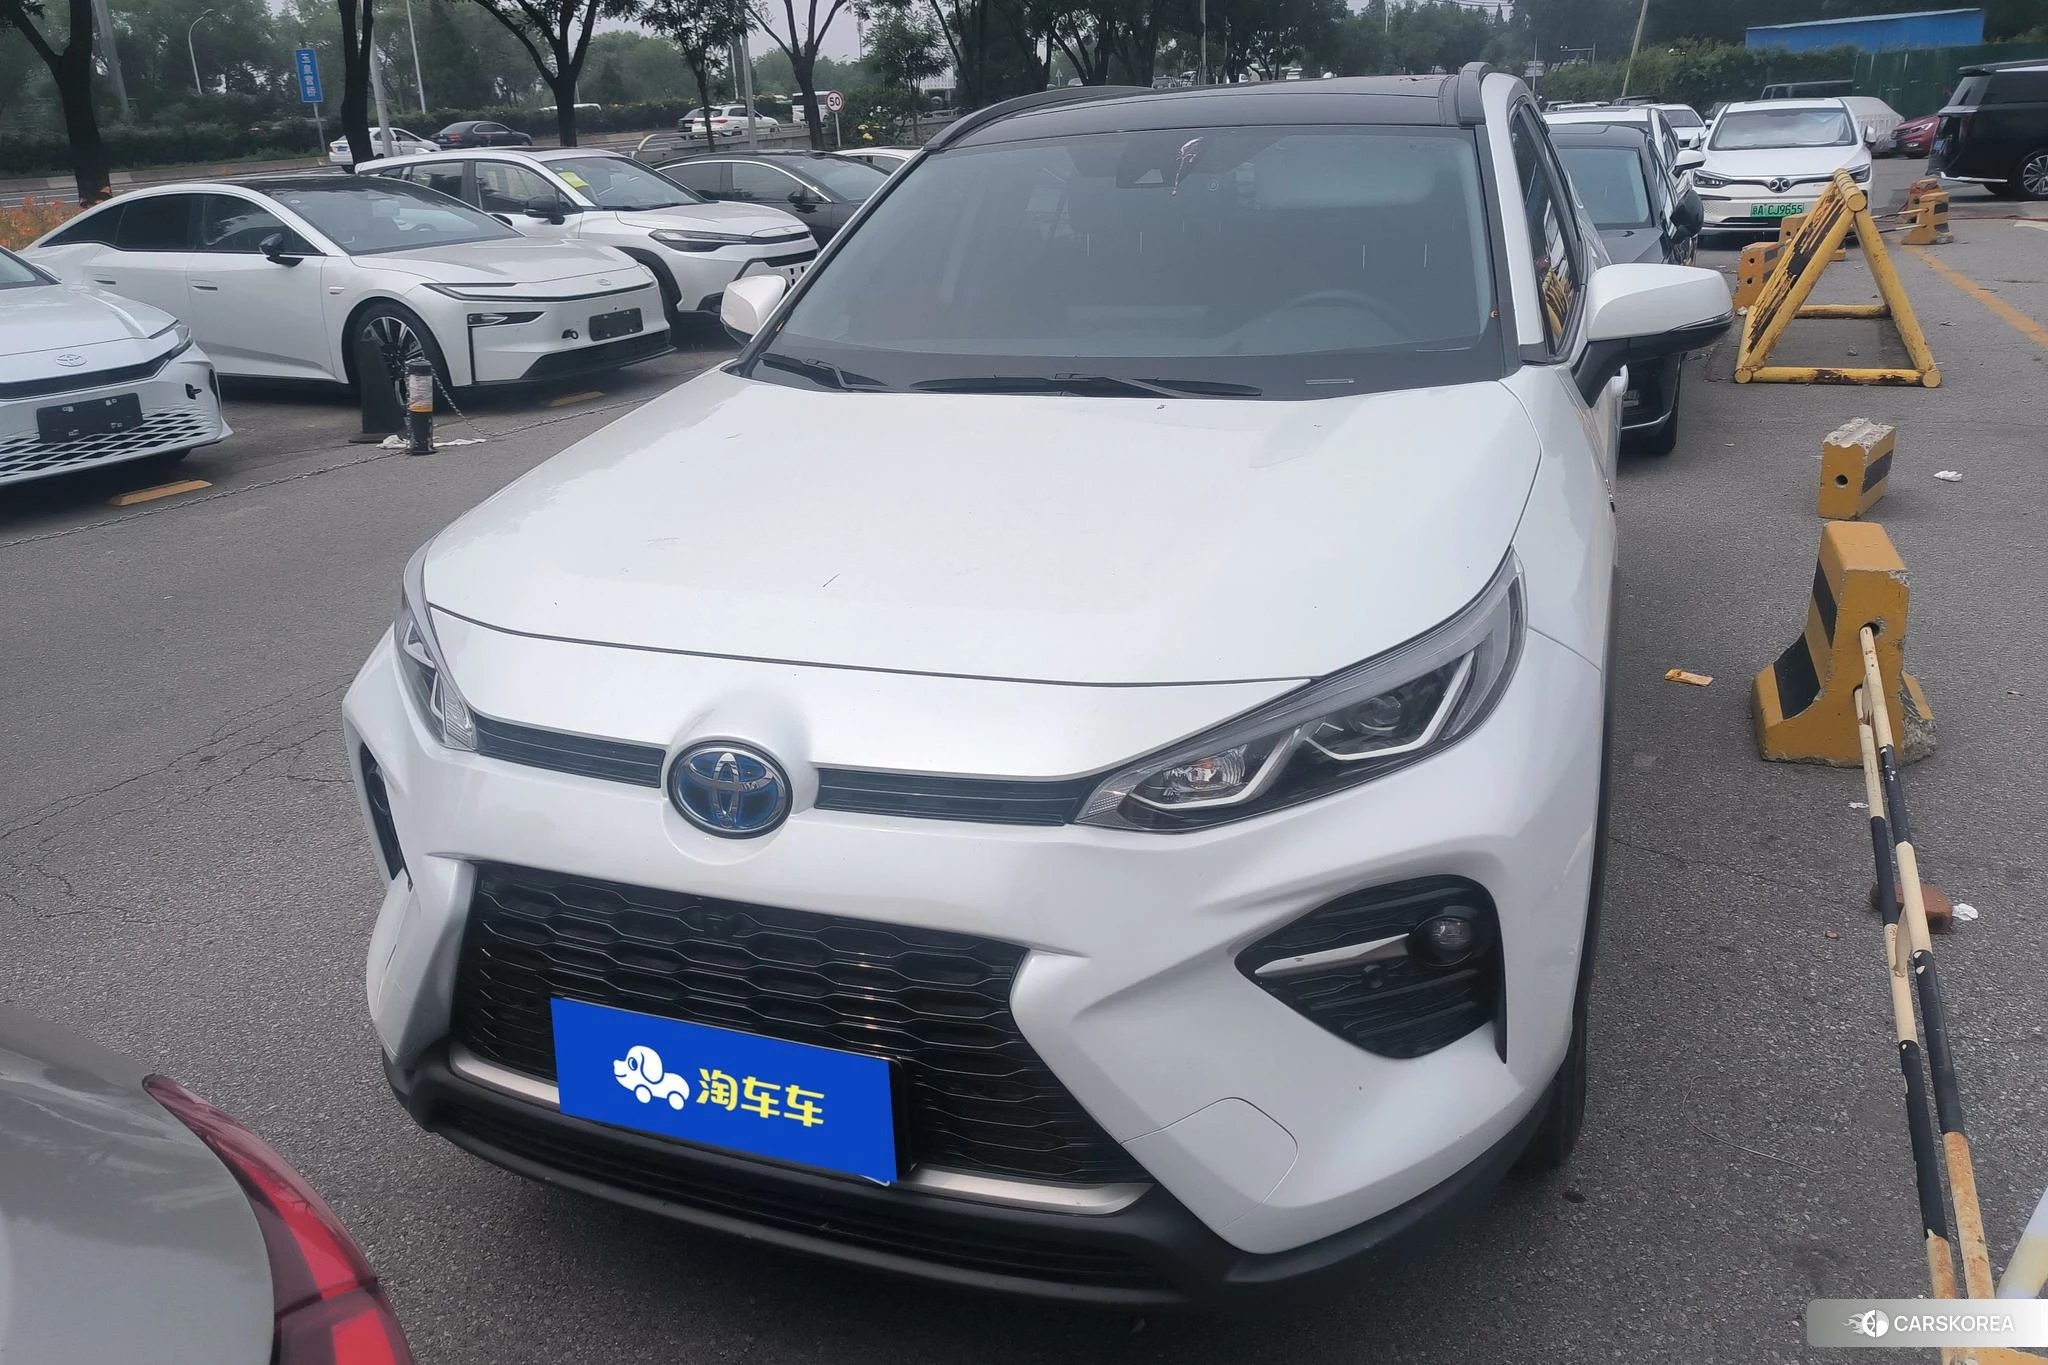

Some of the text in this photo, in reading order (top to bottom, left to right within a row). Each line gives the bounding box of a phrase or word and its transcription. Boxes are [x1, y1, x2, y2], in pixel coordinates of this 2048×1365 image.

[829, 97, 841, 107] 50
[696, 1068, 825, 1128] 淘车车
